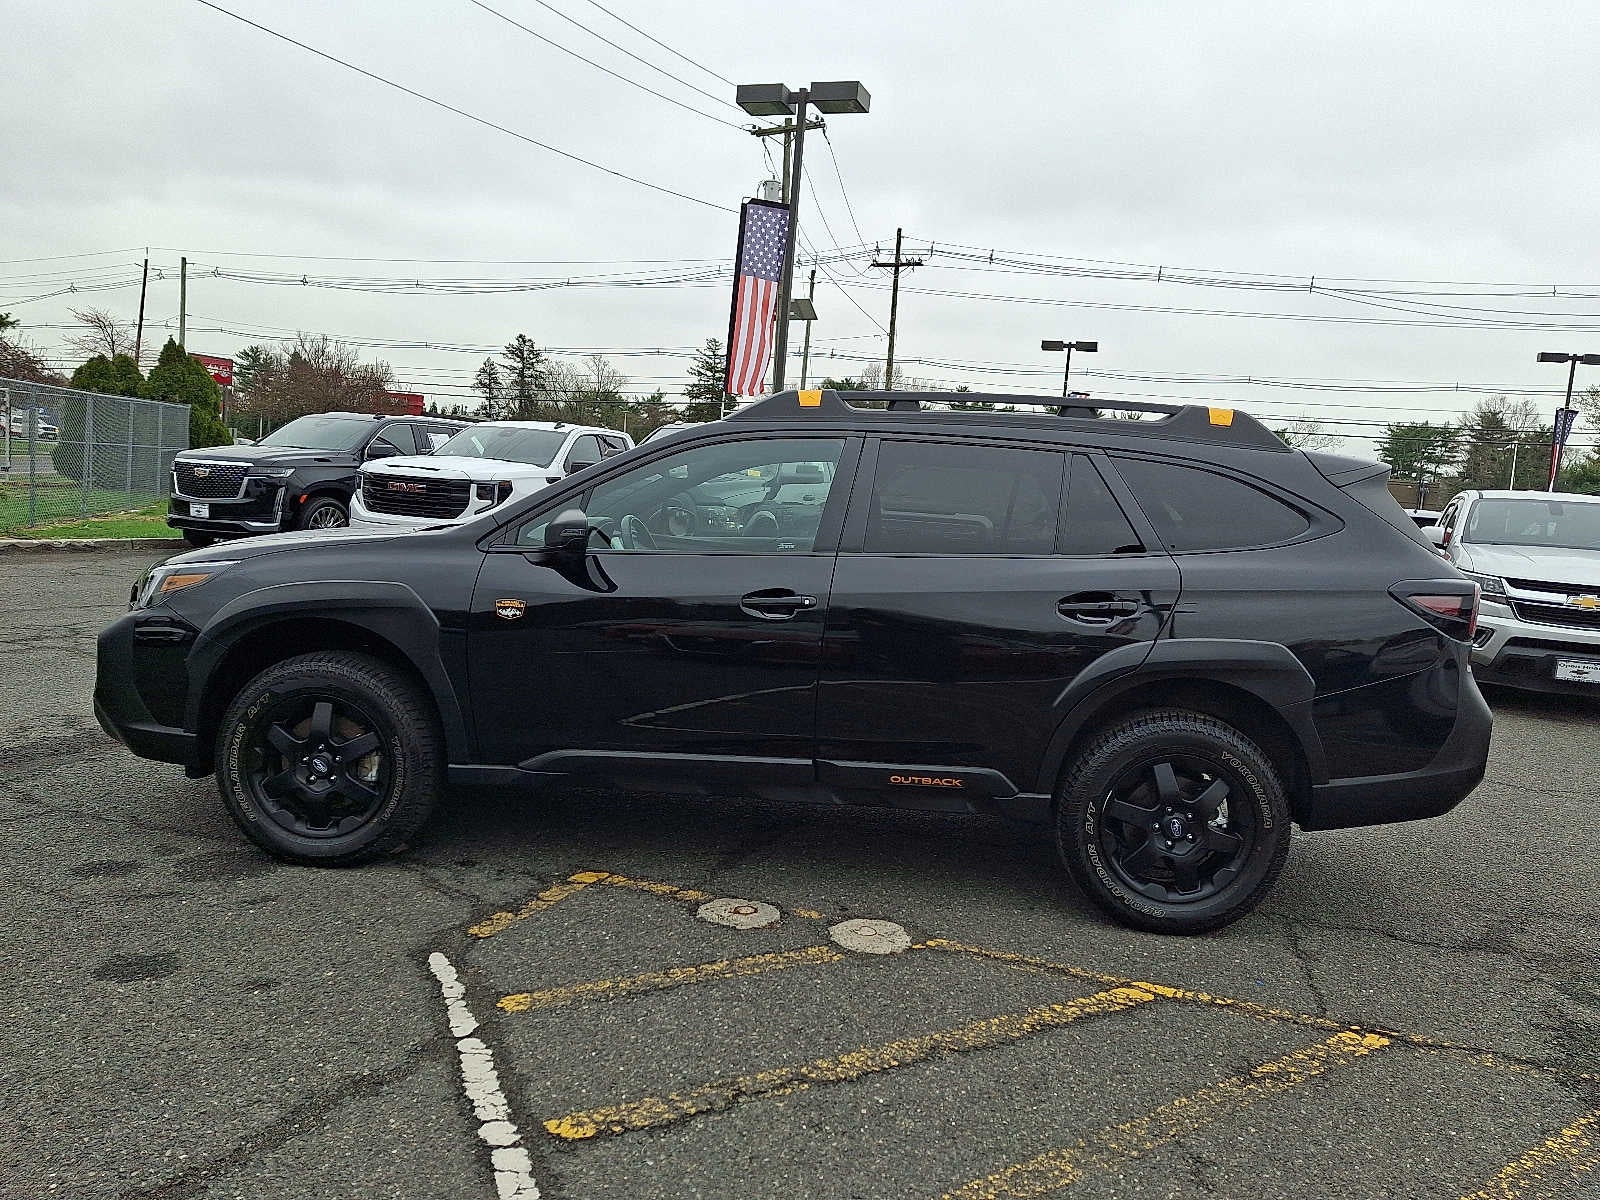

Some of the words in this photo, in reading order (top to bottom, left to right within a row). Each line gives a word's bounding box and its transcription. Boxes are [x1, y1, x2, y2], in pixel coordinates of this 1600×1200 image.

[387, 481, 426, 493] GMC
[229, 722, 257, 822] GEOLANDAR
[247, 692, 270, 719] A/T
[889, 775, 963, 787] OUTBACK
[1221, 751, 1273, 829] YOKOHAMA
[1085, 801, 1096, 835] A/T
[1087, 843, 1165, 918] GEOLANDAR
